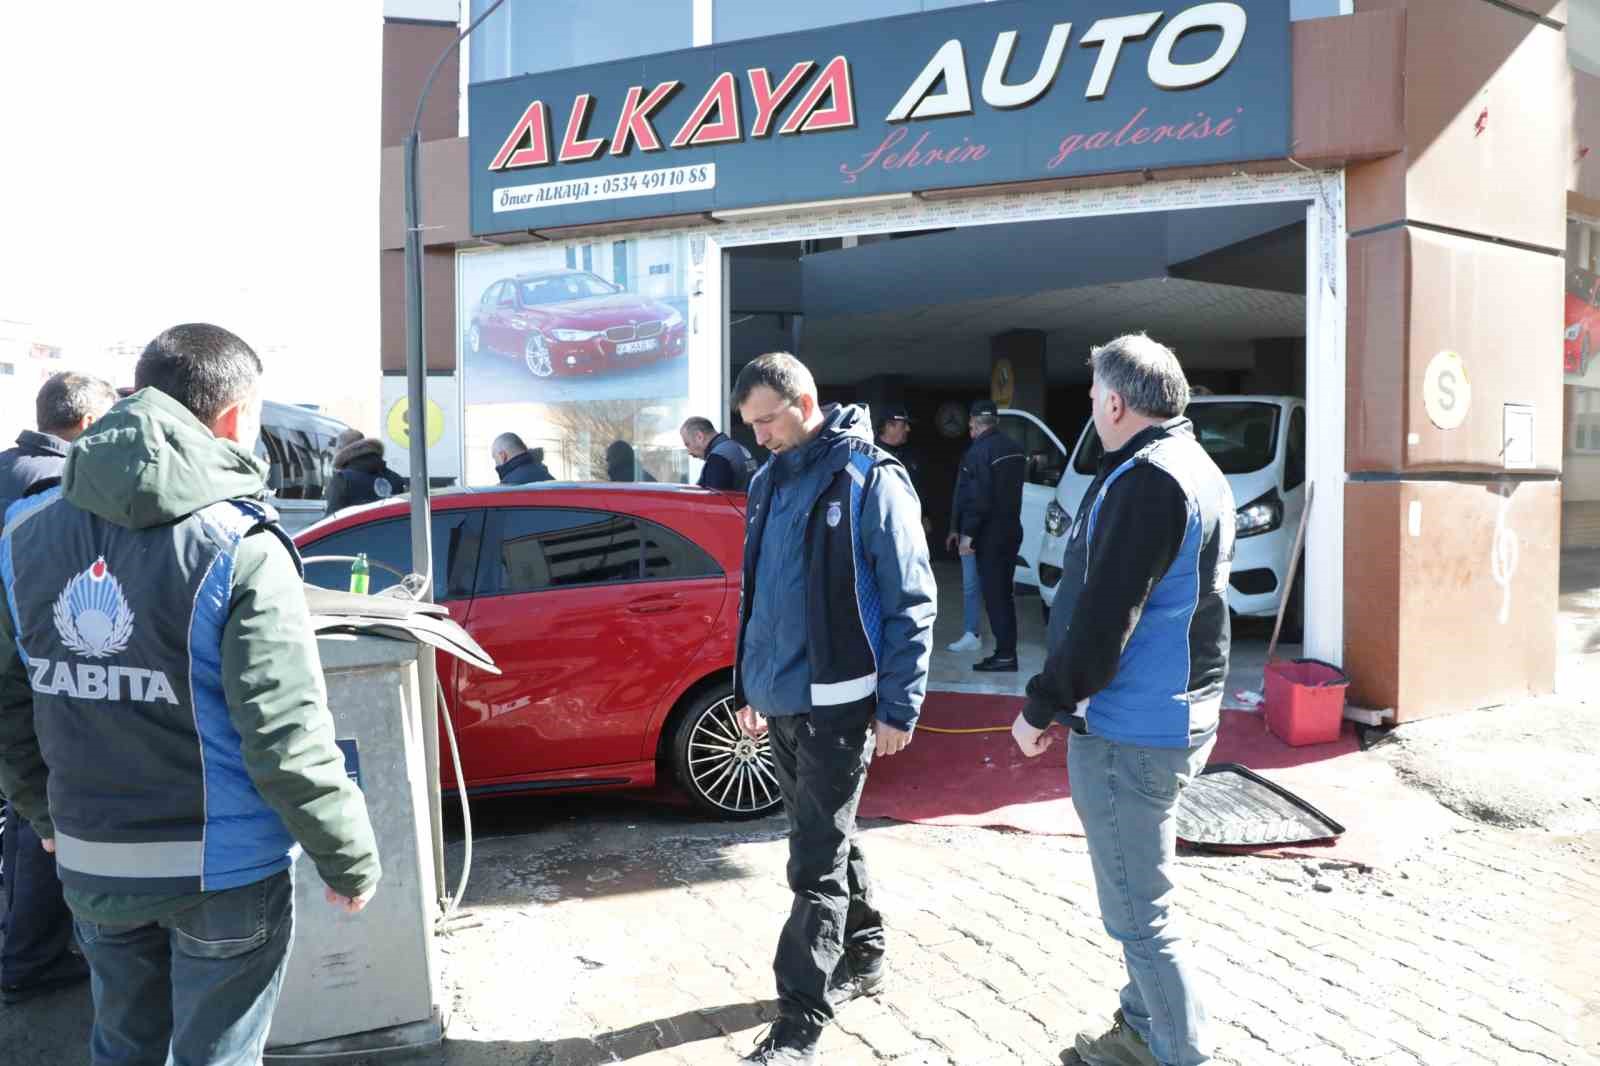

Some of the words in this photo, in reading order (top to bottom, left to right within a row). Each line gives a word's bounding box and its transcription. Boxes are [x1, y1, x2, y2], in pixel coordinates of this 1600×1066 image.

[487, 54, 857, 172] ALKAYA
[885, 1, 1247, 124] AUTO
[1047, 106, 1245, 169] galerisi
[500, 189, 534, 207] Ömer
[536, 182, 590, 203] ALKAYA
[602, 175, 638, 194] 0534
[641, 172, 665, 189] 491
[669, 170, 684, 186] 10
[688, 166, 708, 183] 88
[1437, 370, 1457, 411] S
[28, 657, 180, 706] ZABITA
